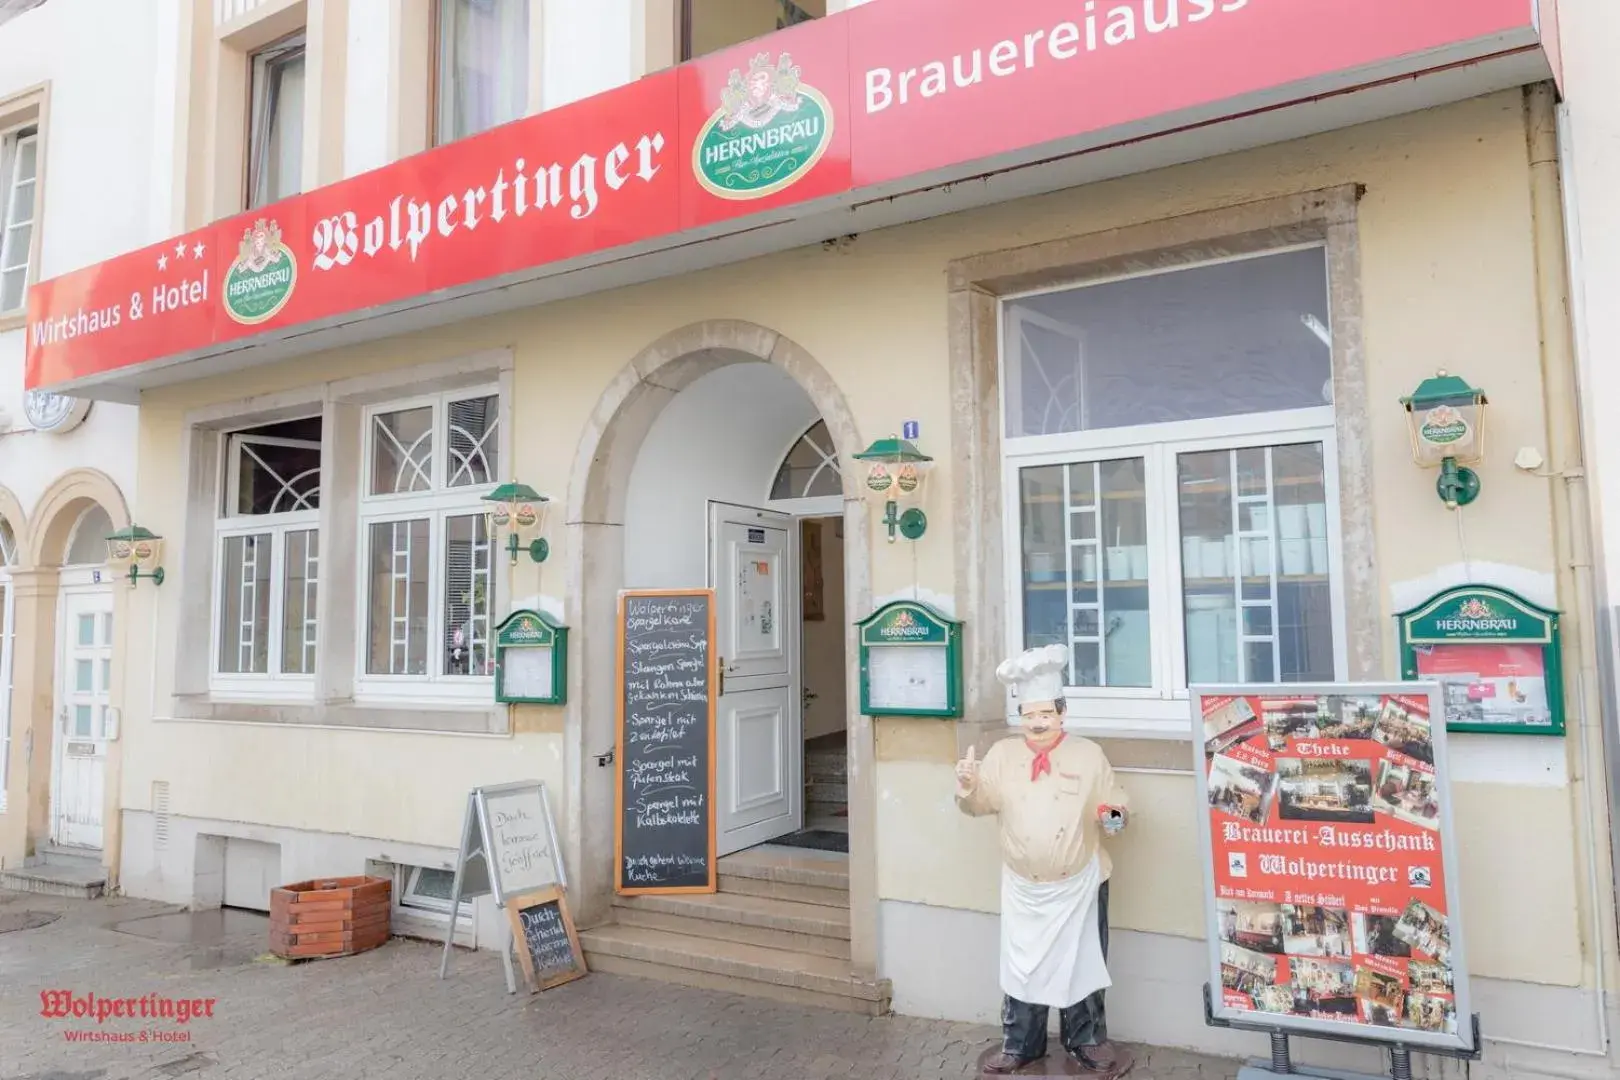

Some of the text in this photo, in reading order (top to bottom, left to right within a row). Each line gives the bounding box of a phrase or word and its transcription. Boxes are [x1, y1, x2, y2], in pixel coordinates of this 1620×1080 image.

[865, 0, 1249, 114] Brauereiaus
[705, 117, 819, 164] HERRNBRÄU
[312, 132, 665, 271] Wolpertinger
[32, 269, 208, 347] Wirtshaus & Hotel
[907, 422, 915, 438] 1
[676, 713, 697, 725] mit
[632, 755, 698, 774] Spargel mit
[682, 794, 704, 806] mit
[1222, 821, 1309, 844] Brauerei
[1259, 854, 1398, 885] Wolpertinger
